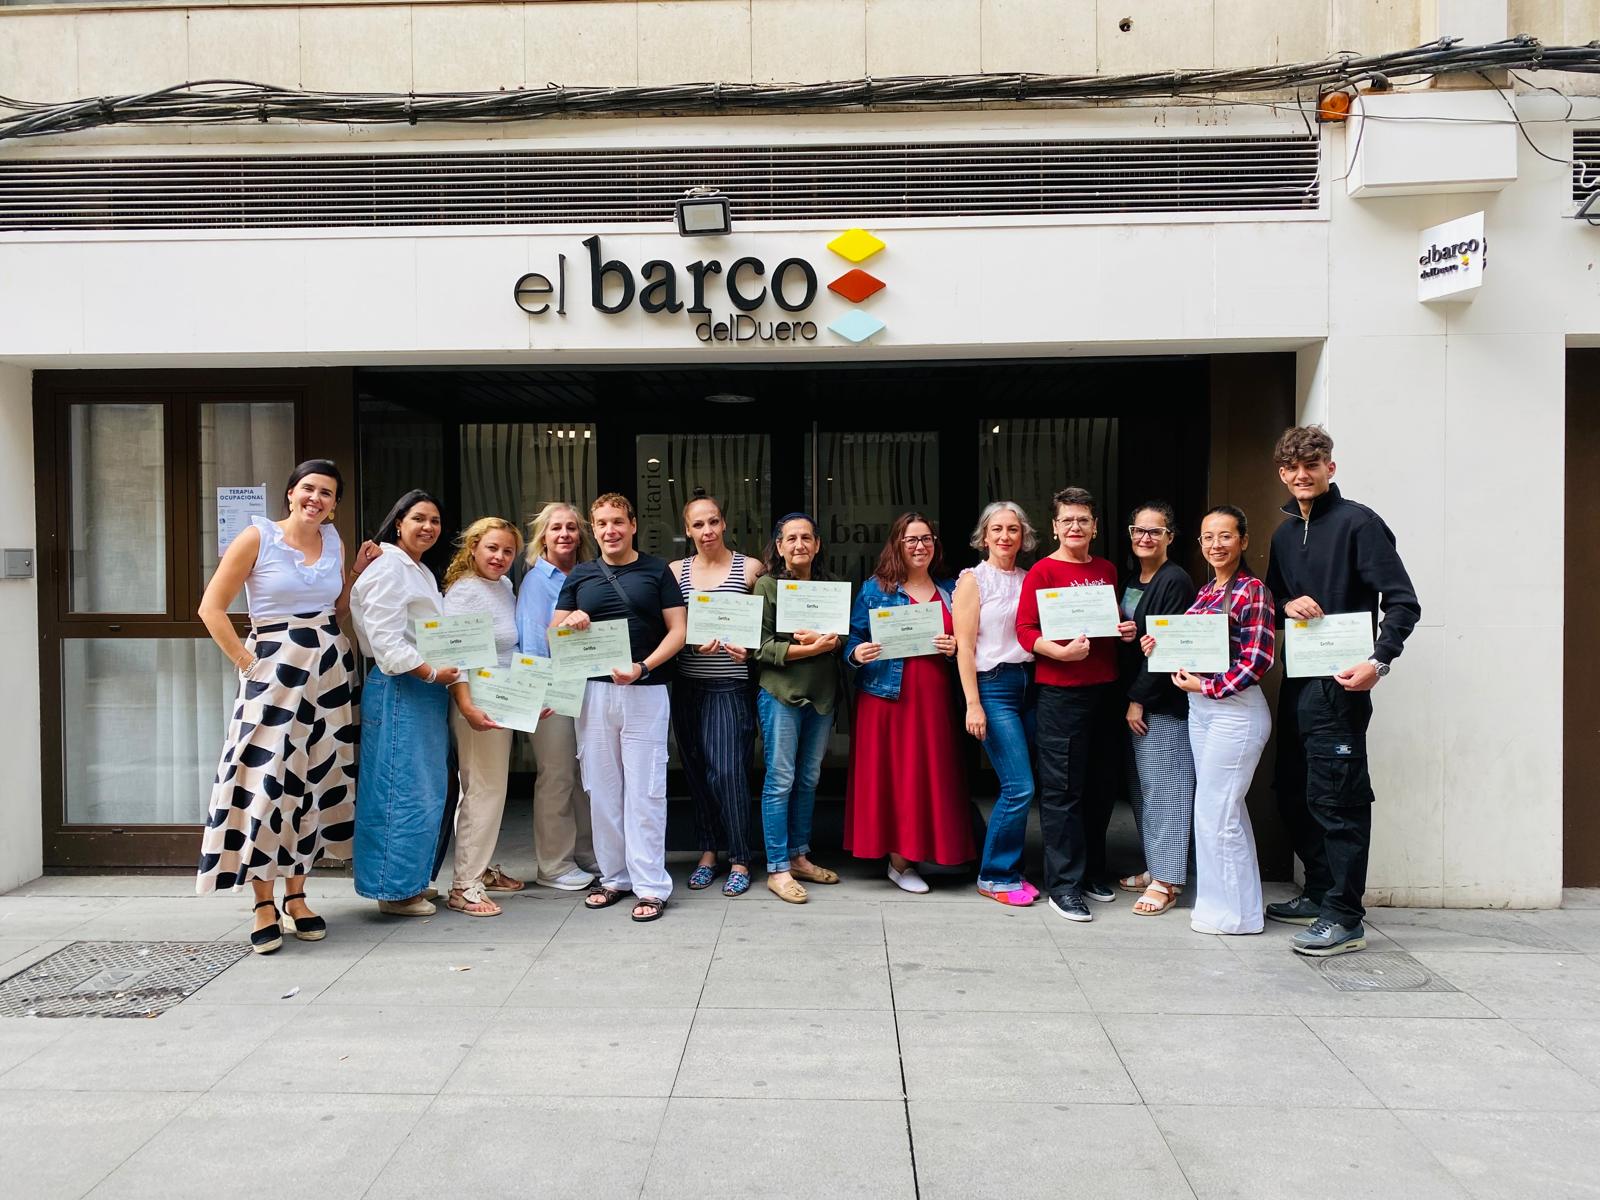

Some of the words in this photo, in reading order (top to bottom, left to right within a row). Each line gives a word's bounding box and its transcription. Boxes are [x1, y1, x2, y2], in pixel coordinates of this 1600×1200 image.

[1419, 249, 1431, 266] el
[1431, 238, 1480, 263] barco
[513, 253, 567, 315] el
[582, 234, 818, 315] barco
[695, 313, 818, 343] delDuero
[830, 513, 888, 545] bar
